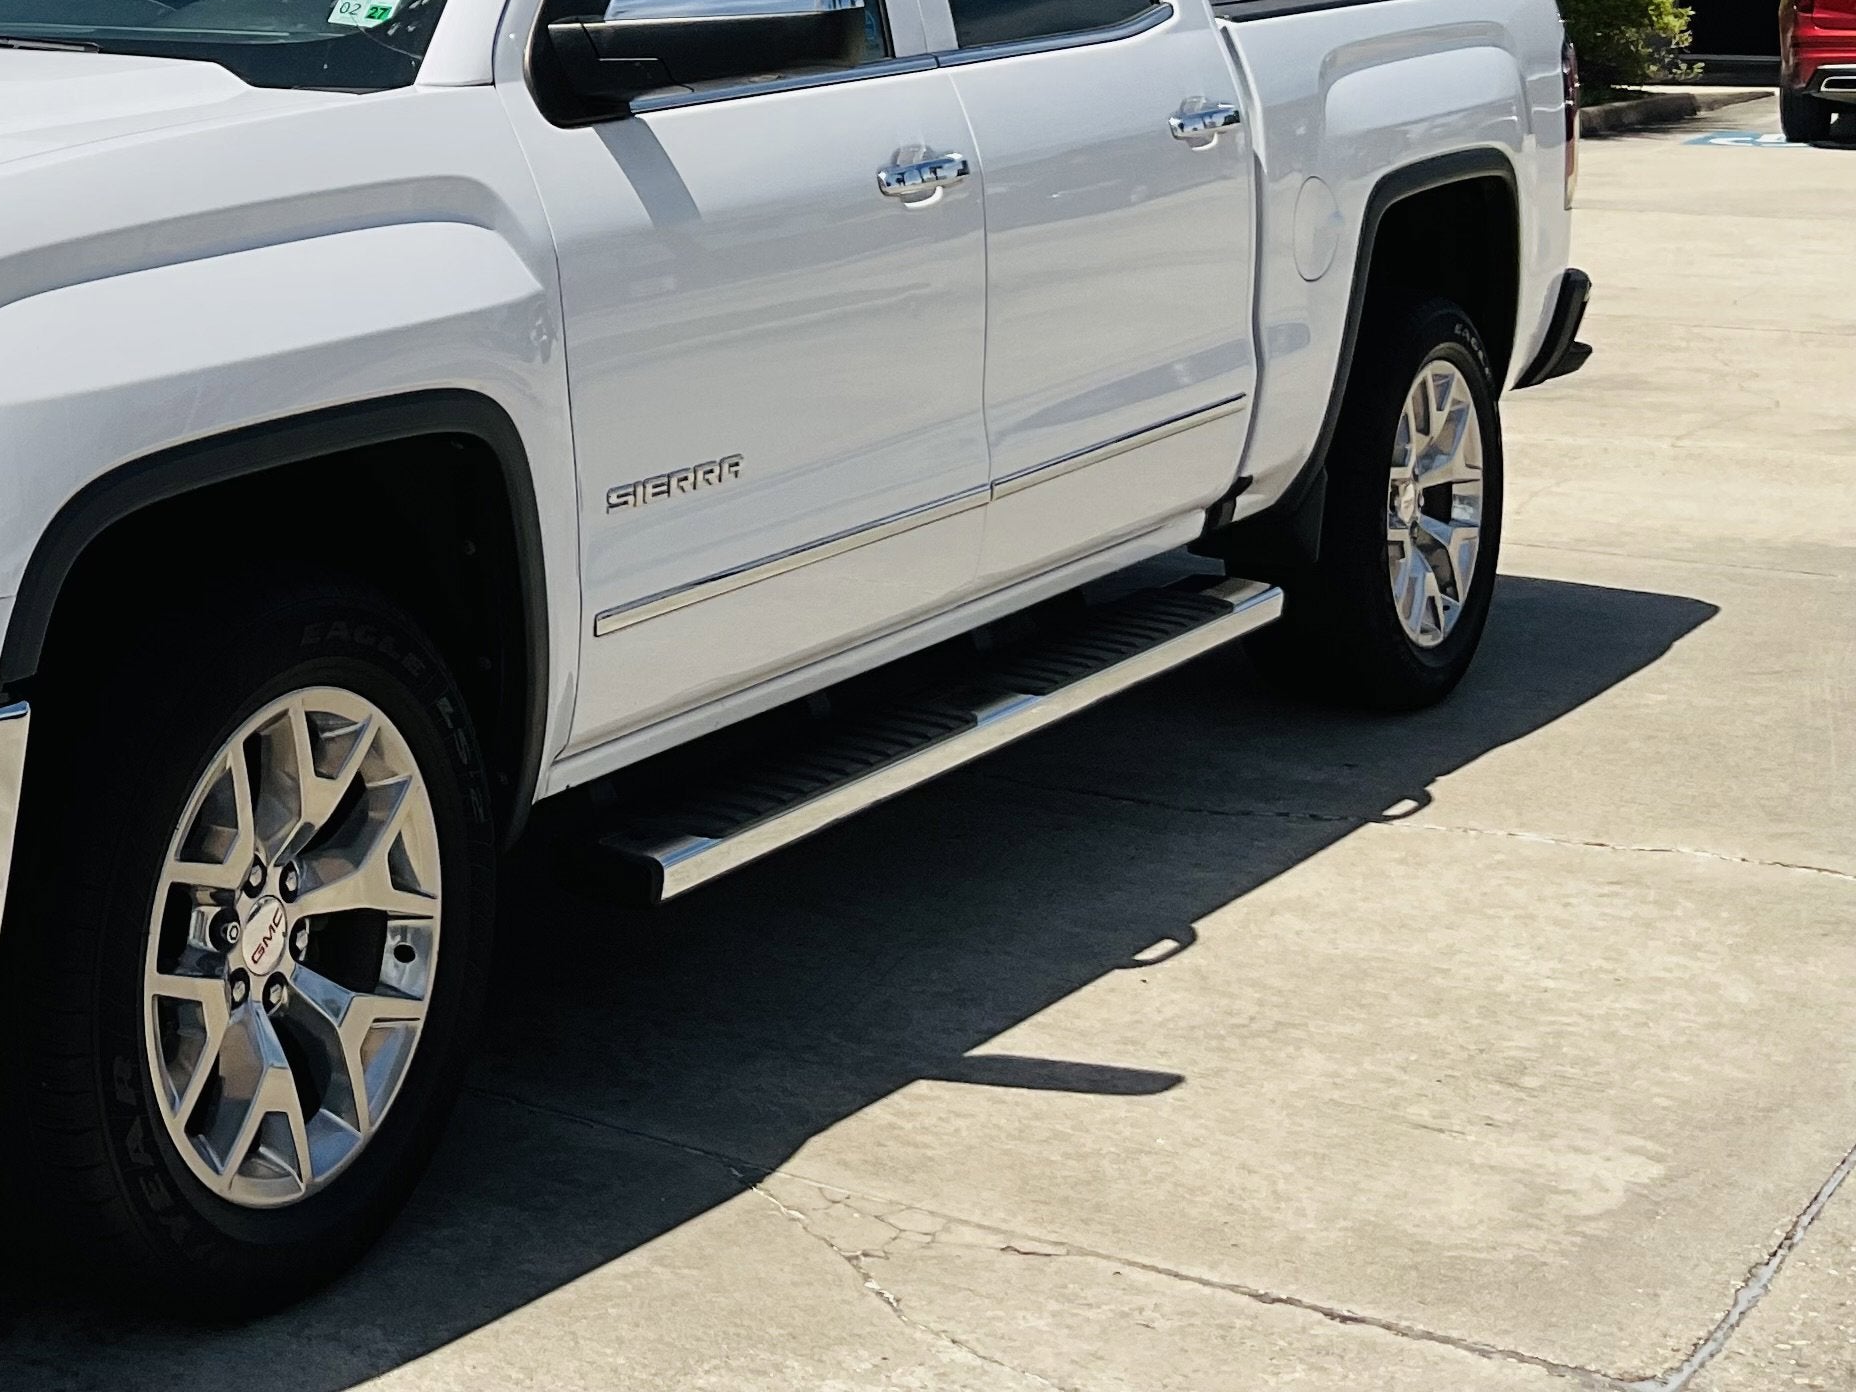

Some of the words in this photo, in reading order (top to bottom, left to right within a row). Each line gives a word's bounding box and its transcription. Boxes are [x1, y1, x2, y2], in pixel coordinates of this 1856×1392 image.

[339, 1, 361, 15] 02
[365, 6, 390, 19] 27
[606, 454, 744, 510] SIERRA
[299, 620, 427, 678] EAGLE
[251, 907, 283, 964] GMC
